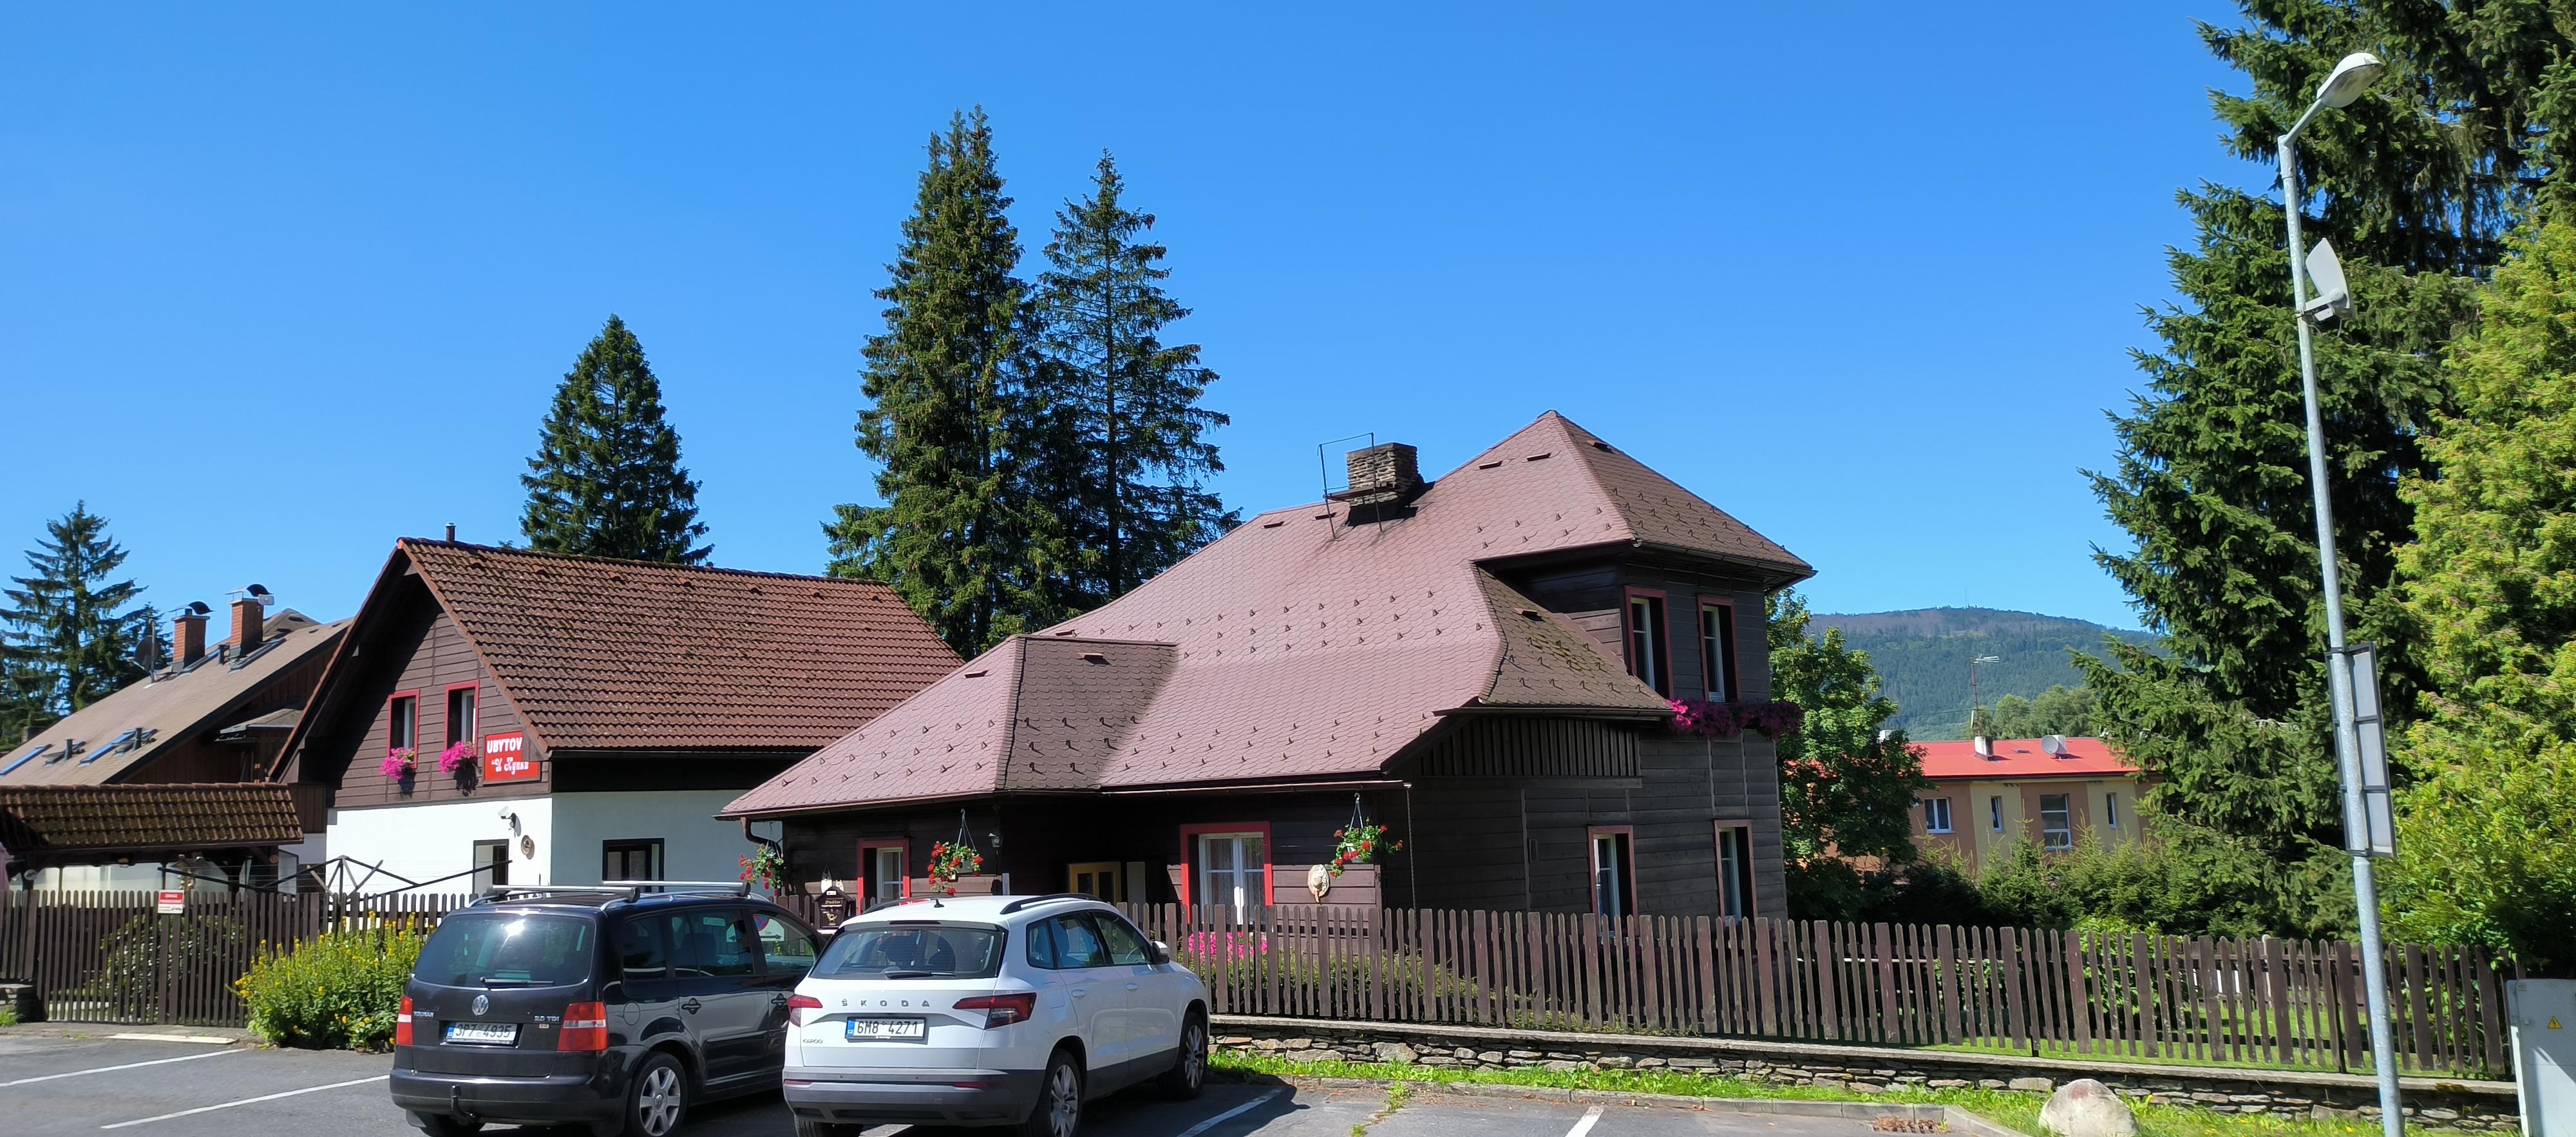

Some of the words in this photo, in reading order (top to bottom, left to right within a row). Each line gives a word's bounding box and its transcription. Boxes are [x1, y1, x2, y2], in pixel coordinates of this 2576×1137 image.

[841, 998, 930, 1007] ŠKODA
[455, 1024, 477, 1037] 3P7
[482, 1024, 512, 1038] 4935
[857, 1020, 879, 1034] 6M8
[888, 1020, 918, 1035] 4271
